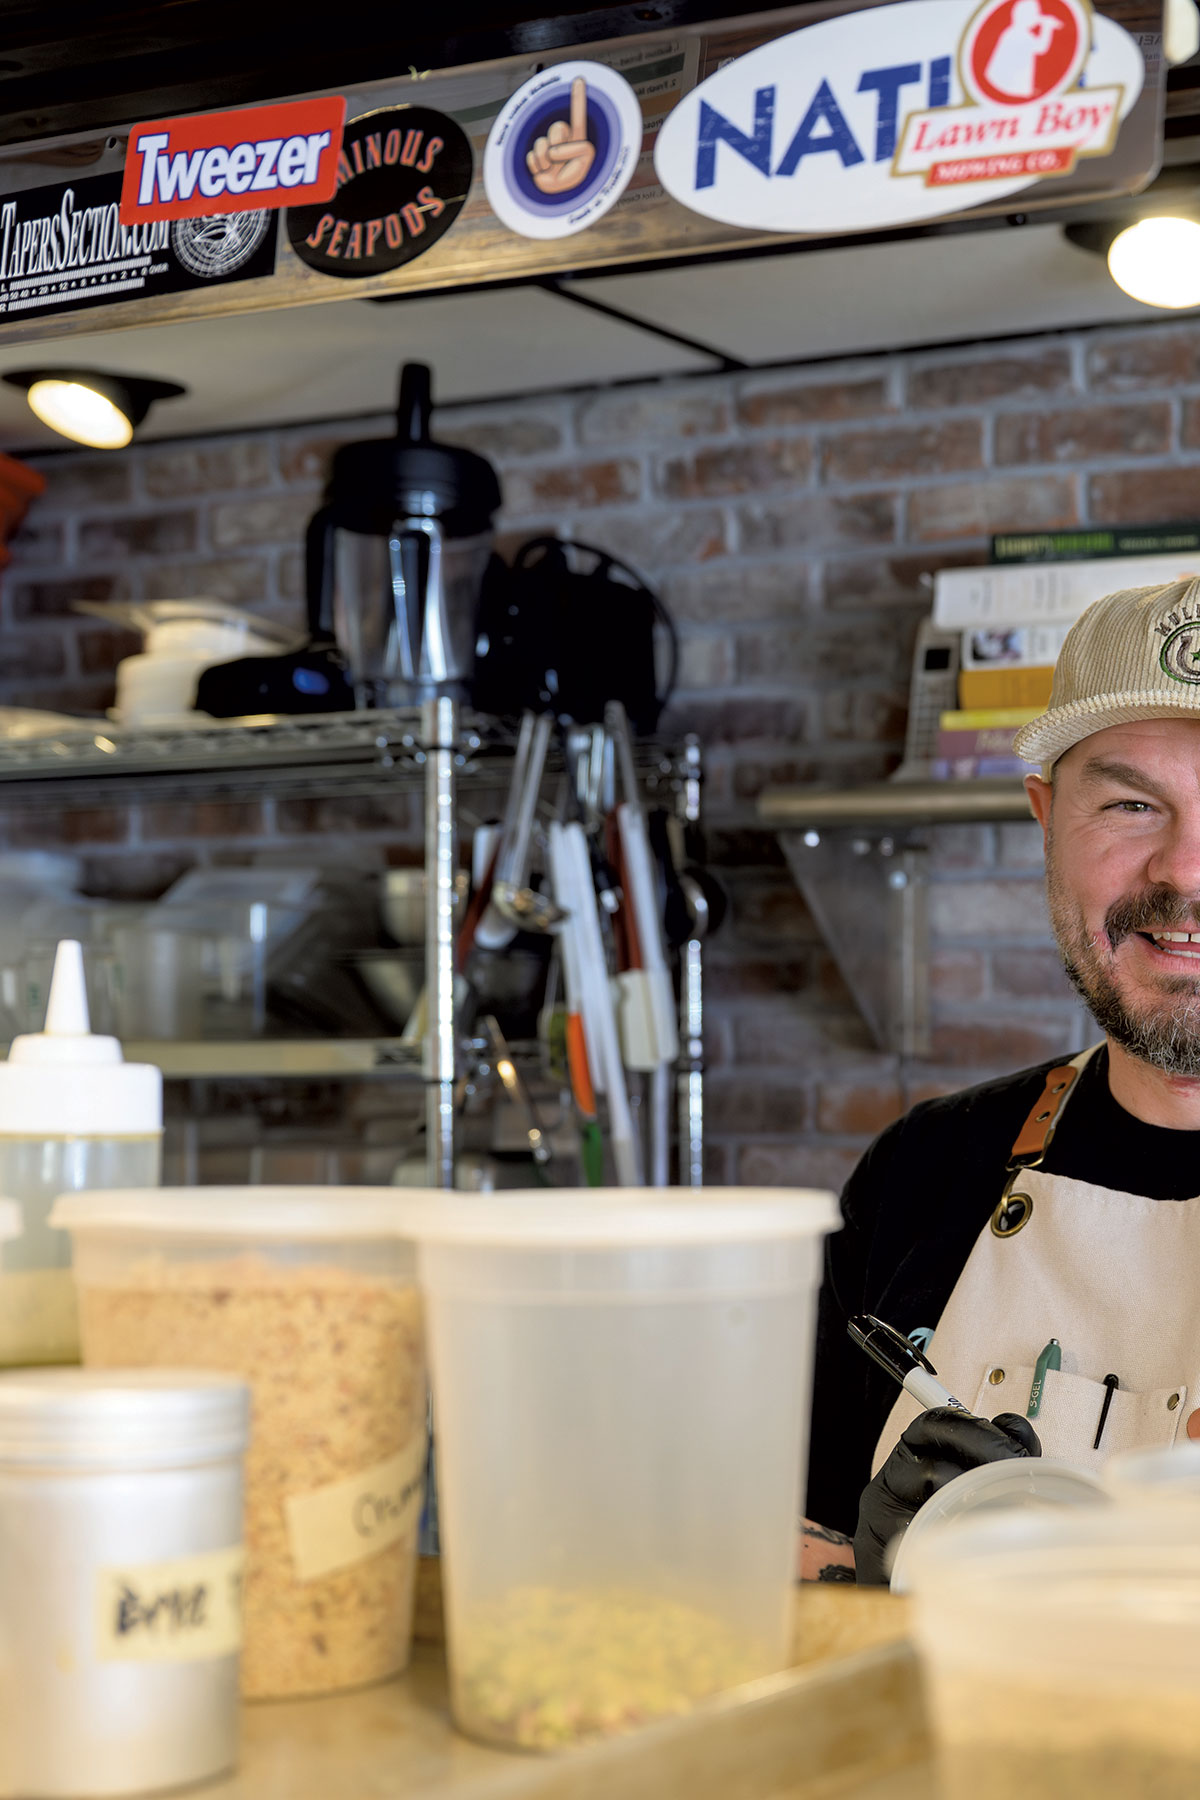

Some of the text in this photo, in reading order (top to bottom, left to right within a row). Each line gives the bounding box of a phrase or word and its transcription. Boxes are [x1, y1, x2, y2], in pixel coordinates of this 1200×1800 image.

[694, 54, 953, 190] NATI
[912, 102, 1112, 153] Lawn Boy
[136, 130, 331, 206] Tweezer
[337, 128, 444, 189] MINOUS
[305, 185, 446, 260] SEAPODS
[39, 285, 50, 296] 20
[58, 281, 69, 291] 12
[120, 270, 128, 280] 2
[148, 262, 170, 276] OVER
[1029, 1379, 1042, 1408] S-GEL
